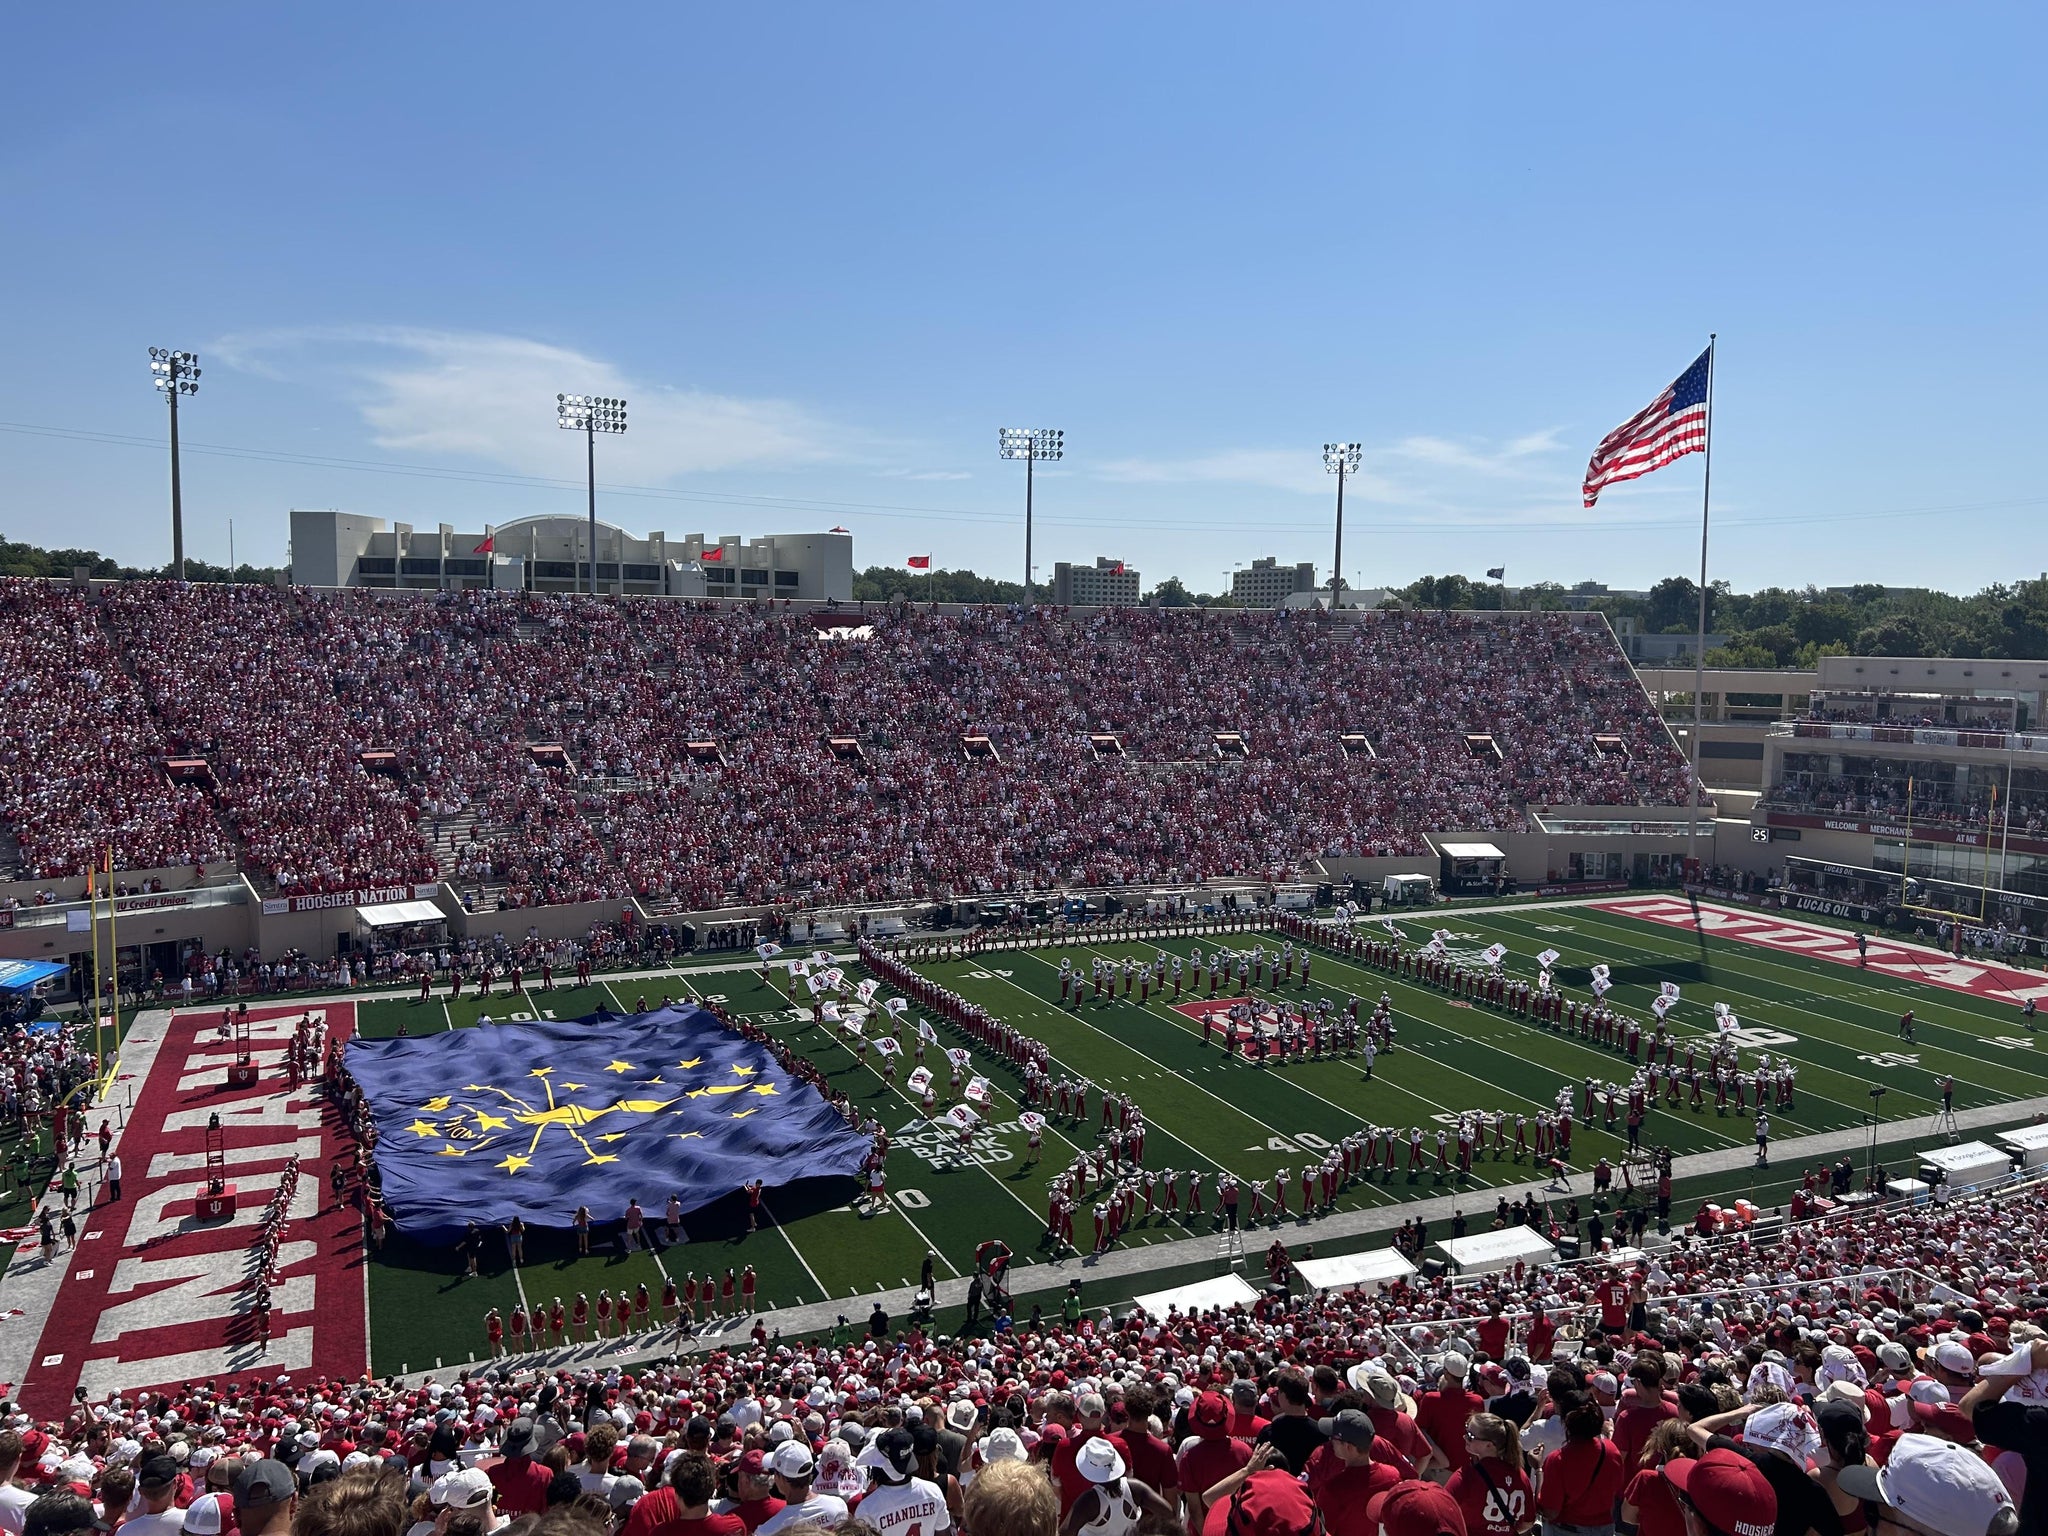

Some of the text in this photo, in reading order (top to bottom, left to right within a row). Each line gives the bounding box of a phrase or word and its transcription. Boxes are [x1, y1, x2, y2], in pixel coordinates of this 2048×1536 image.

[1753, 829, 1767, 841] 25
[1824, 820, 1977, 844] WELCOME MERCHANTS AT ME
[1823, 865, 1854, 876] LUCAS OIL
[117, 896, 187, 910] IU Credit Union
[296, 887, 408, 911] HOOSIER NATION
[1796, 897, 1850, 917] LUCAS OIL
[1998, 893, 2035, 906] LUCAS OIL
[888, 1121, 1023, 1150] ERCHNT
[1267, 1132, 1332, 1153] 40
[928, 1149, 1014, 1170] FIELD
[1611, 1291, 1624, 1306] 15
[1482, 1487, 1526, 1522] 80
[879, 1502, 936, 1530] CHANDLER
